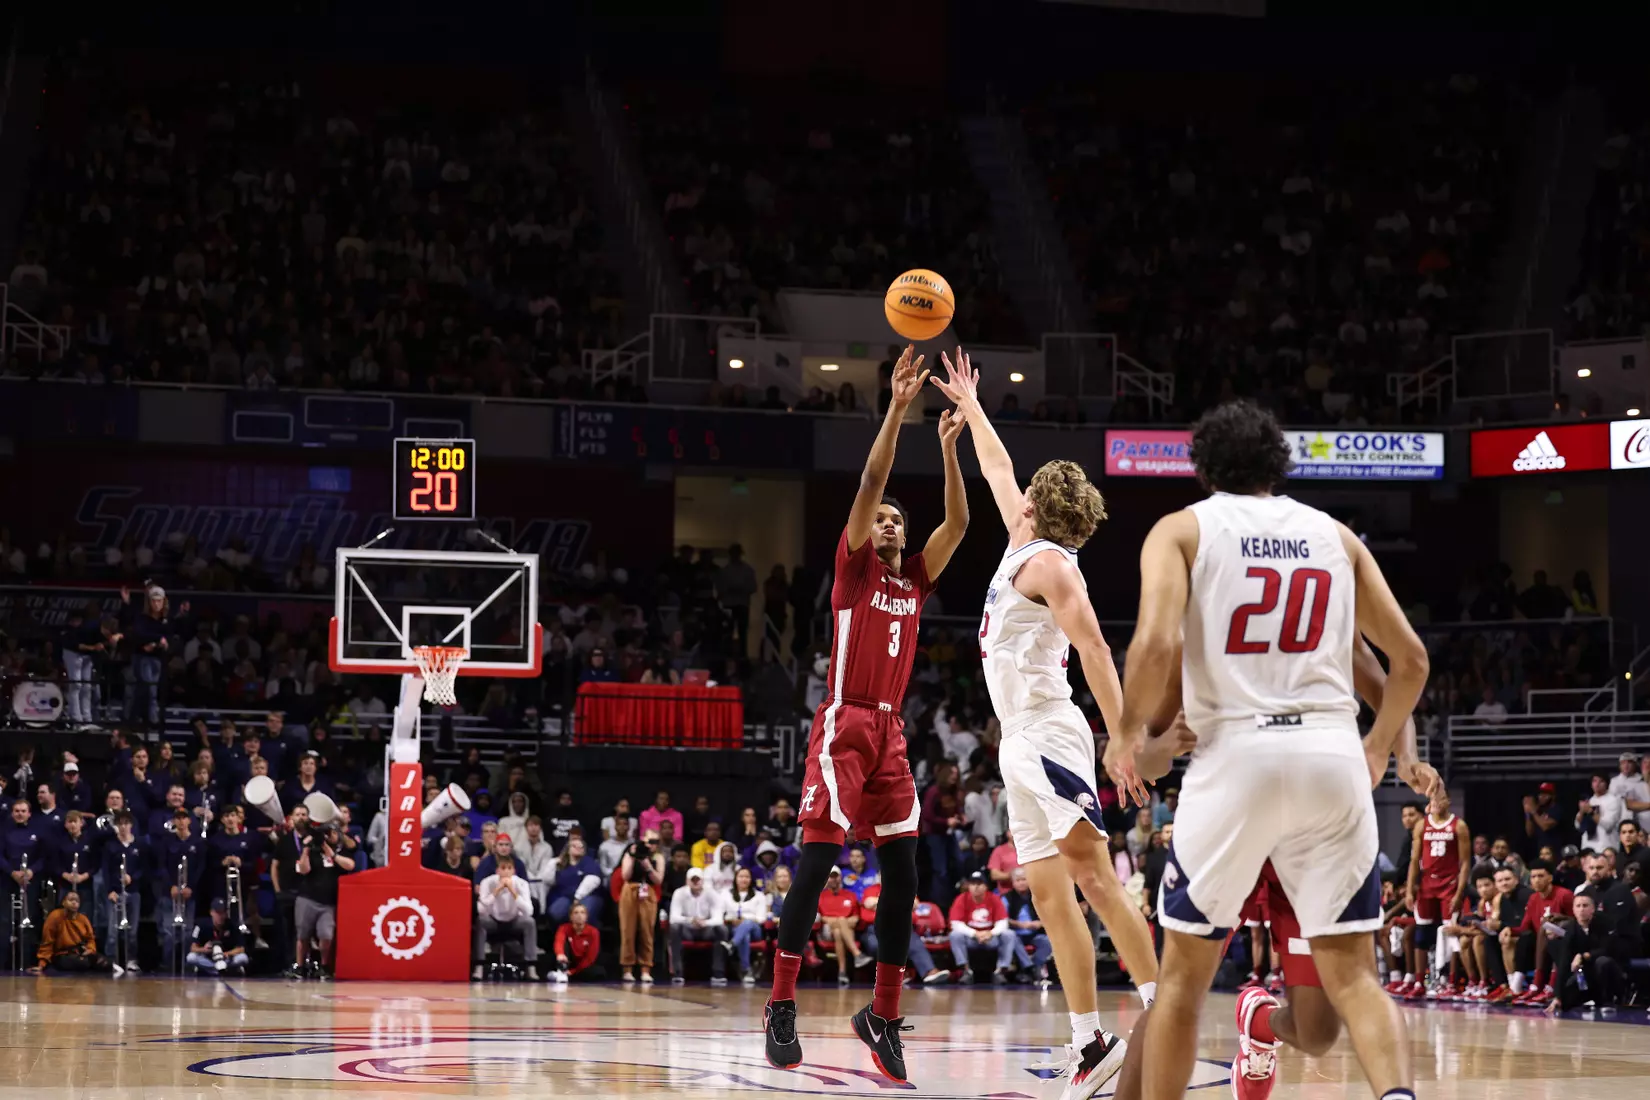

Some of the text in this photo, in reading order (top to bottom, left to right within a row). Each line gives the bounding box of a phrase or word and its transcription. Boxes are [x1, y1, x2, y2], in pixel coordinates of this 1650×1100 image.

[899, 295, 933, 311] NCAA
[1335, 434, 1427, 451] COOK'S
[410, 447, 466, 471] 12:00
[1335, 452, 1425, 462] PEST CONTROL
[1513, 455, 1567, 472] adidas
[410, 471, 458, 512] 20
[1240, 536, 1310, 559] KEARING
[1224, 566, 1332, 655] 20
[888, 621, 901, 658] 3
[399, 769, 417, 857] JAGS
[387, 914, 420, 944] pf
